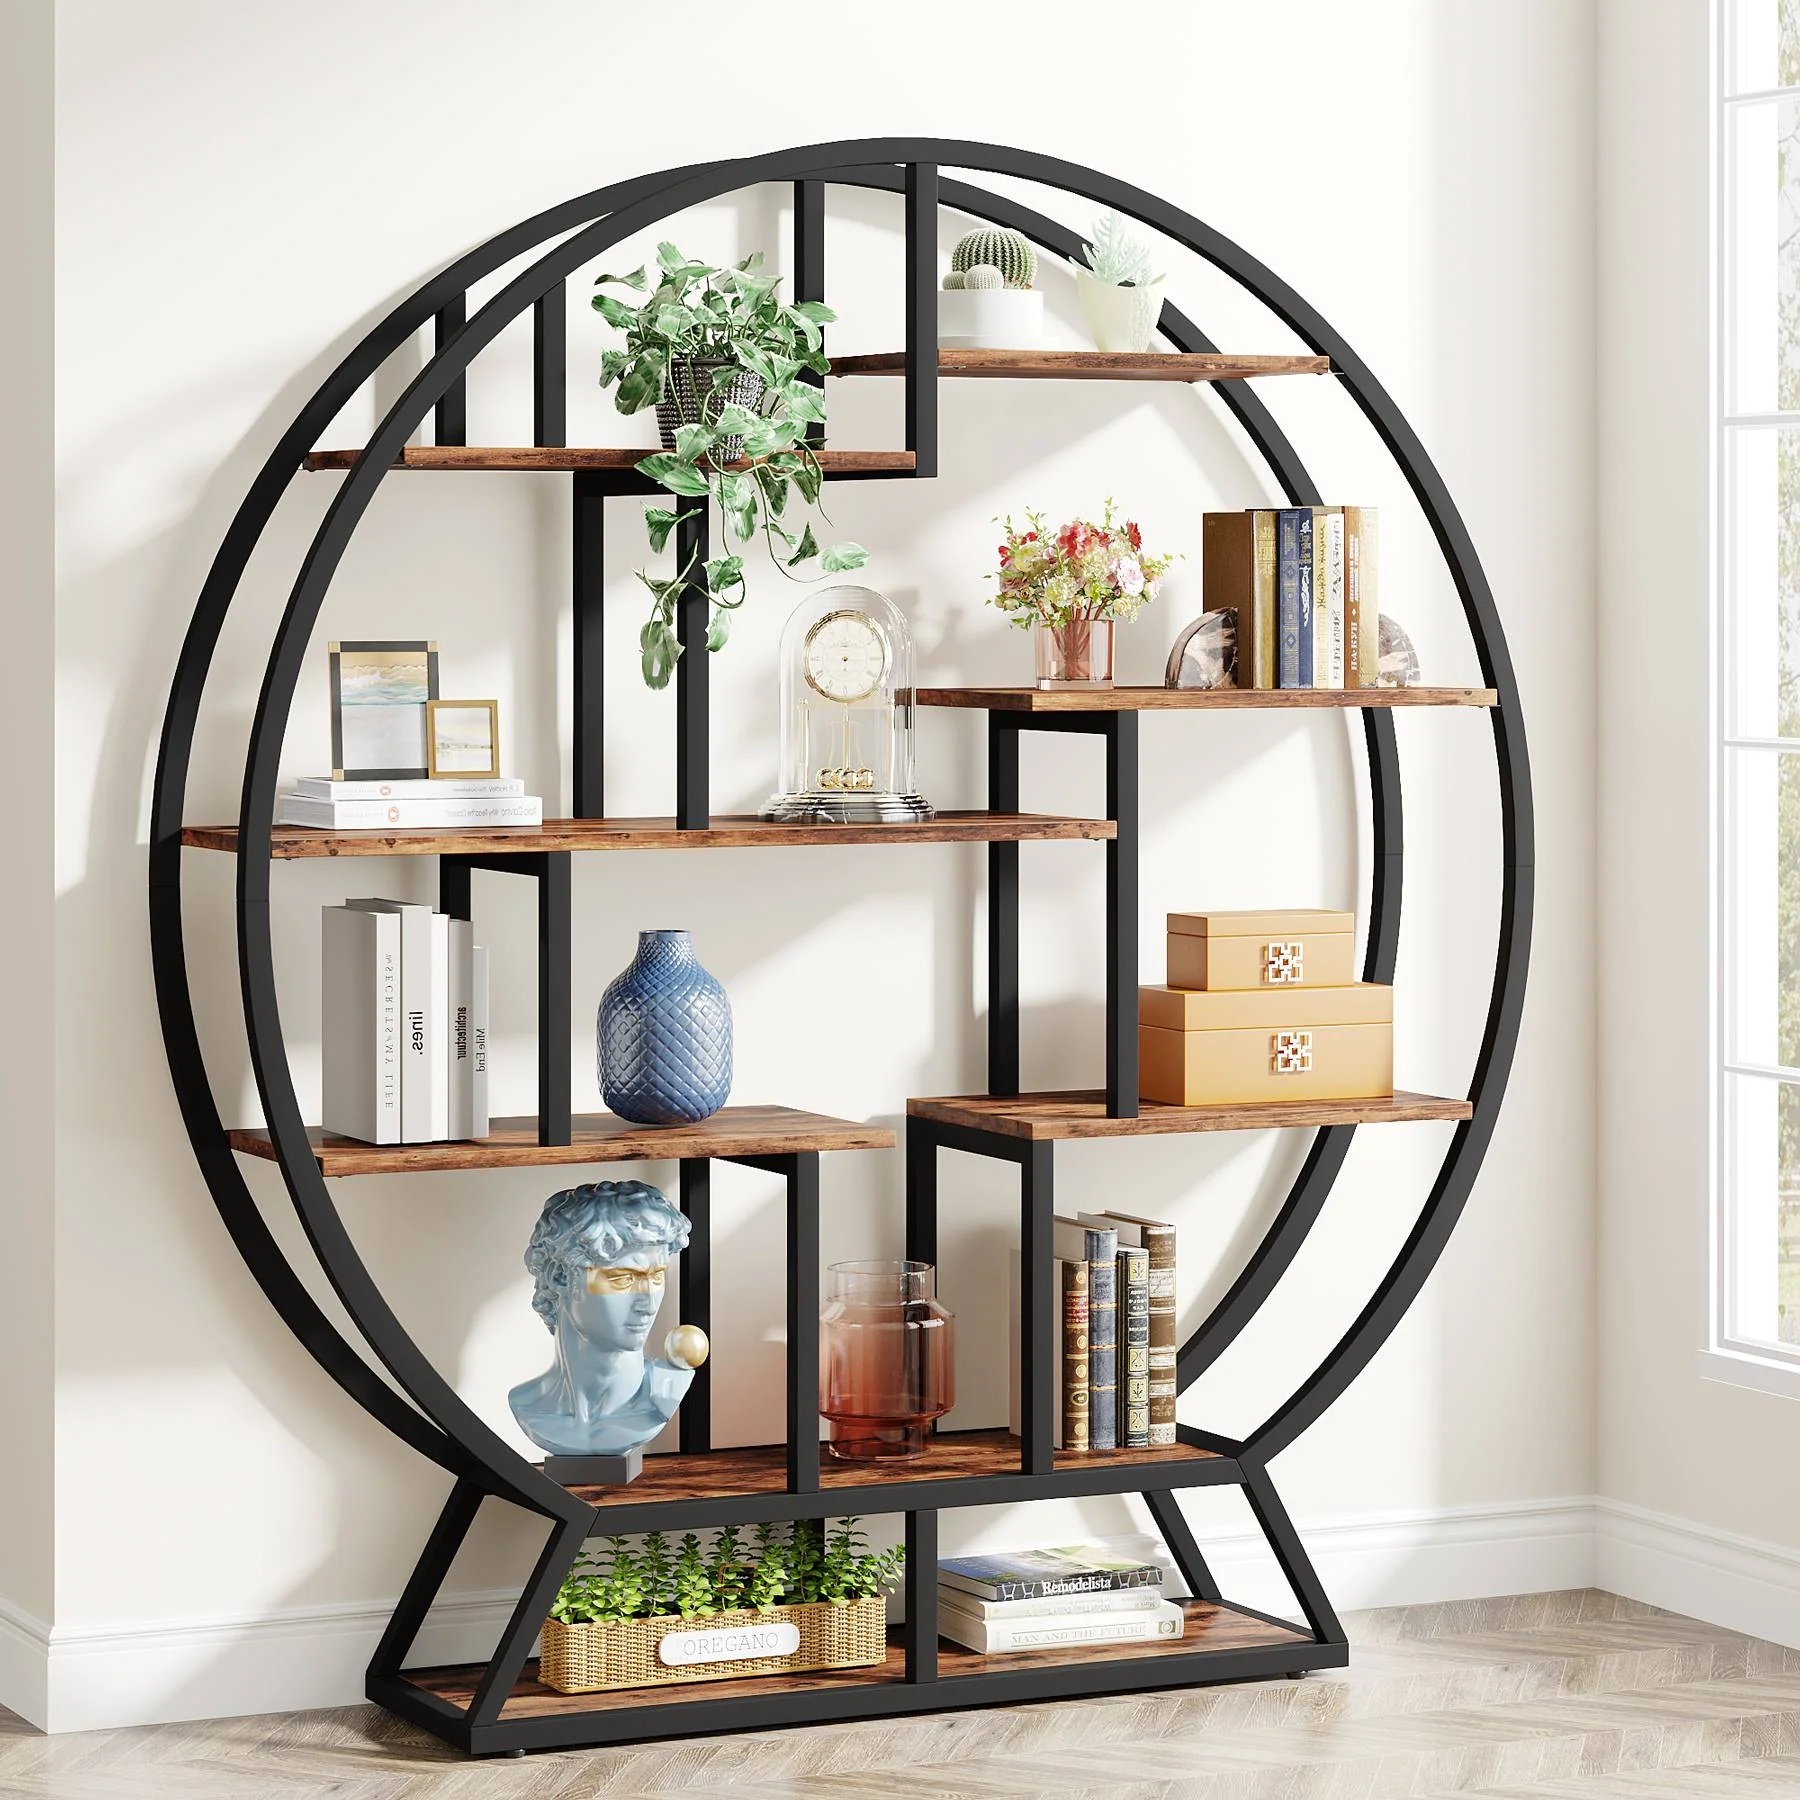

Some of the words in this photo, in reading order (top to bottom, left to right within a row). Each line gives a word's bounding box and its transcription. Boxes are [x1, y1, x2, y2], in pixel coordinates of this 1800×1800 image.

[1042, 1576, 1112, 1595] Remodelista
[683, 1632, 779, 1655] OREGANO
[1011, 1633, 1039, 1645] MAN
[1045, 1631, 1068, 1641] AND
[1072, 1628, 1098, 1639] THE
[1101, 1625, 1146, 1636] FUTURE
